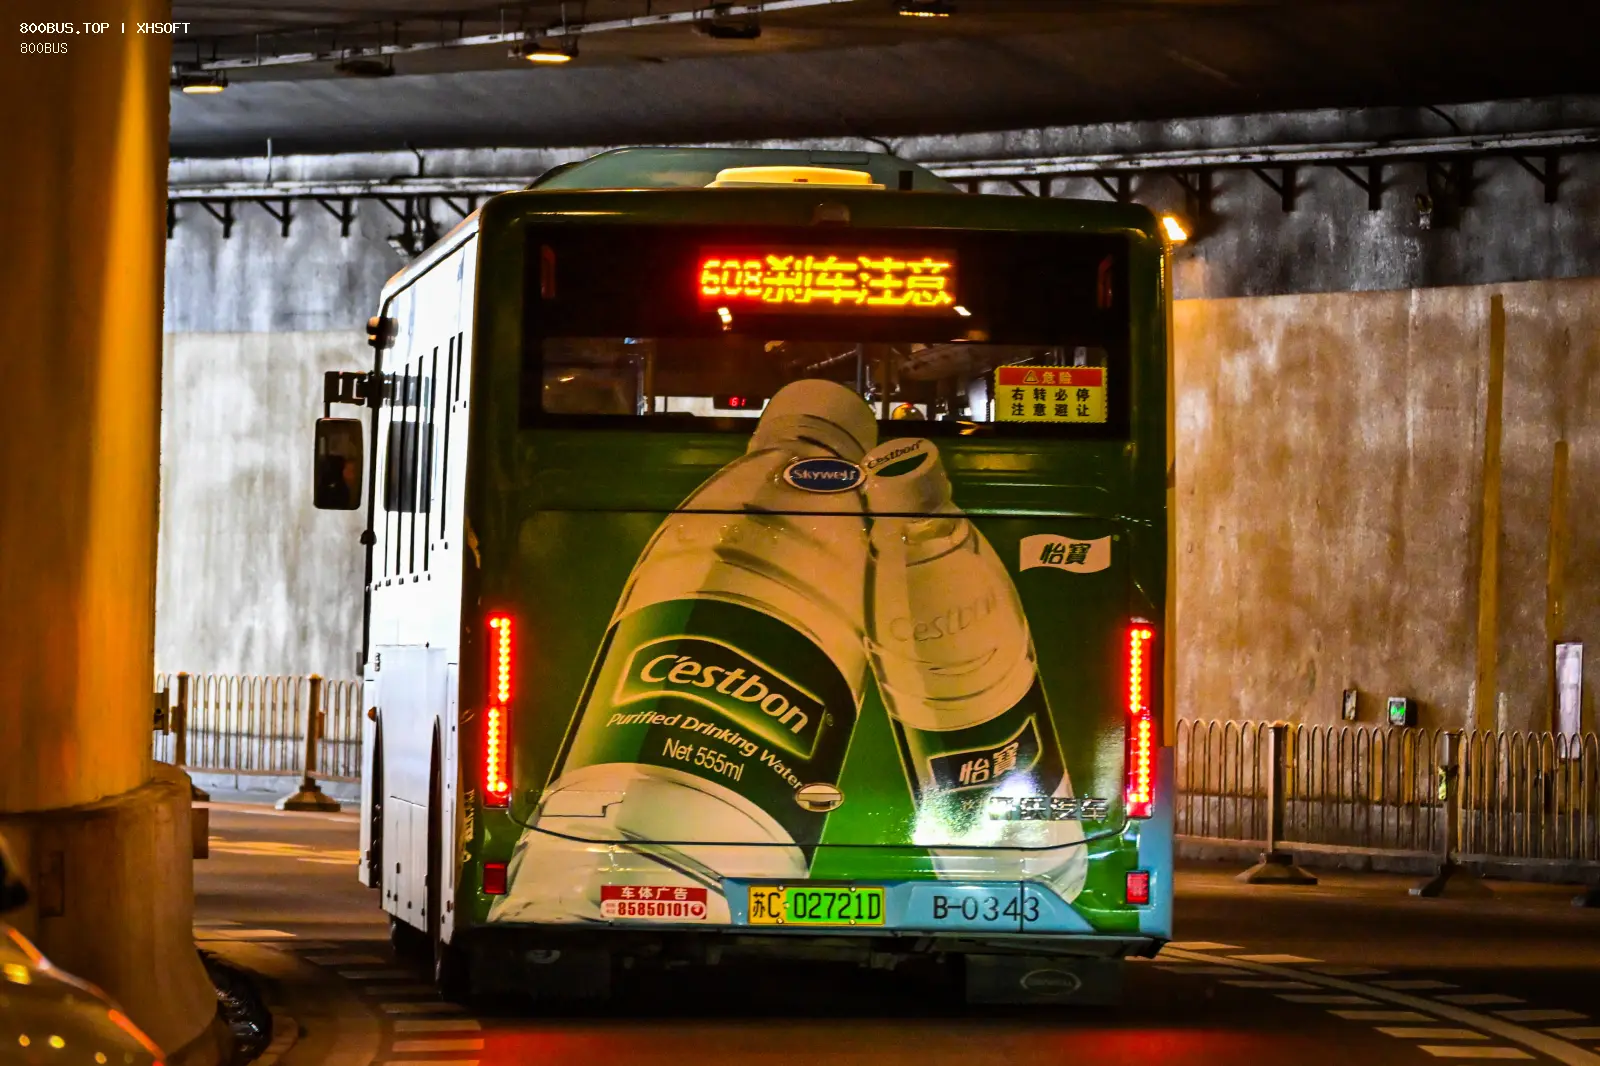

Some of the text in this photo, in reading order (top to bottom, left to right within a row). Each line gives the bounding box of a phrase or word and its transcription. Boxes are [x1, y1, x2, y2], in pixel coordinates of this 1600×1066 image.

[1042, 371, 1072, 385] 危险
[1011, 387, 1090, 402] 右转必停
[1011, 403, 1090, 417] 注意避让
[606, 710, 803, 789] Purified Drinking Water
[662, 737, 746, 782] Net 555ml
[620, 886, 689, 900] 车体广告
[618, 902, 689, 917] 85850101
[933, 895, 1040, 922] B-0343
